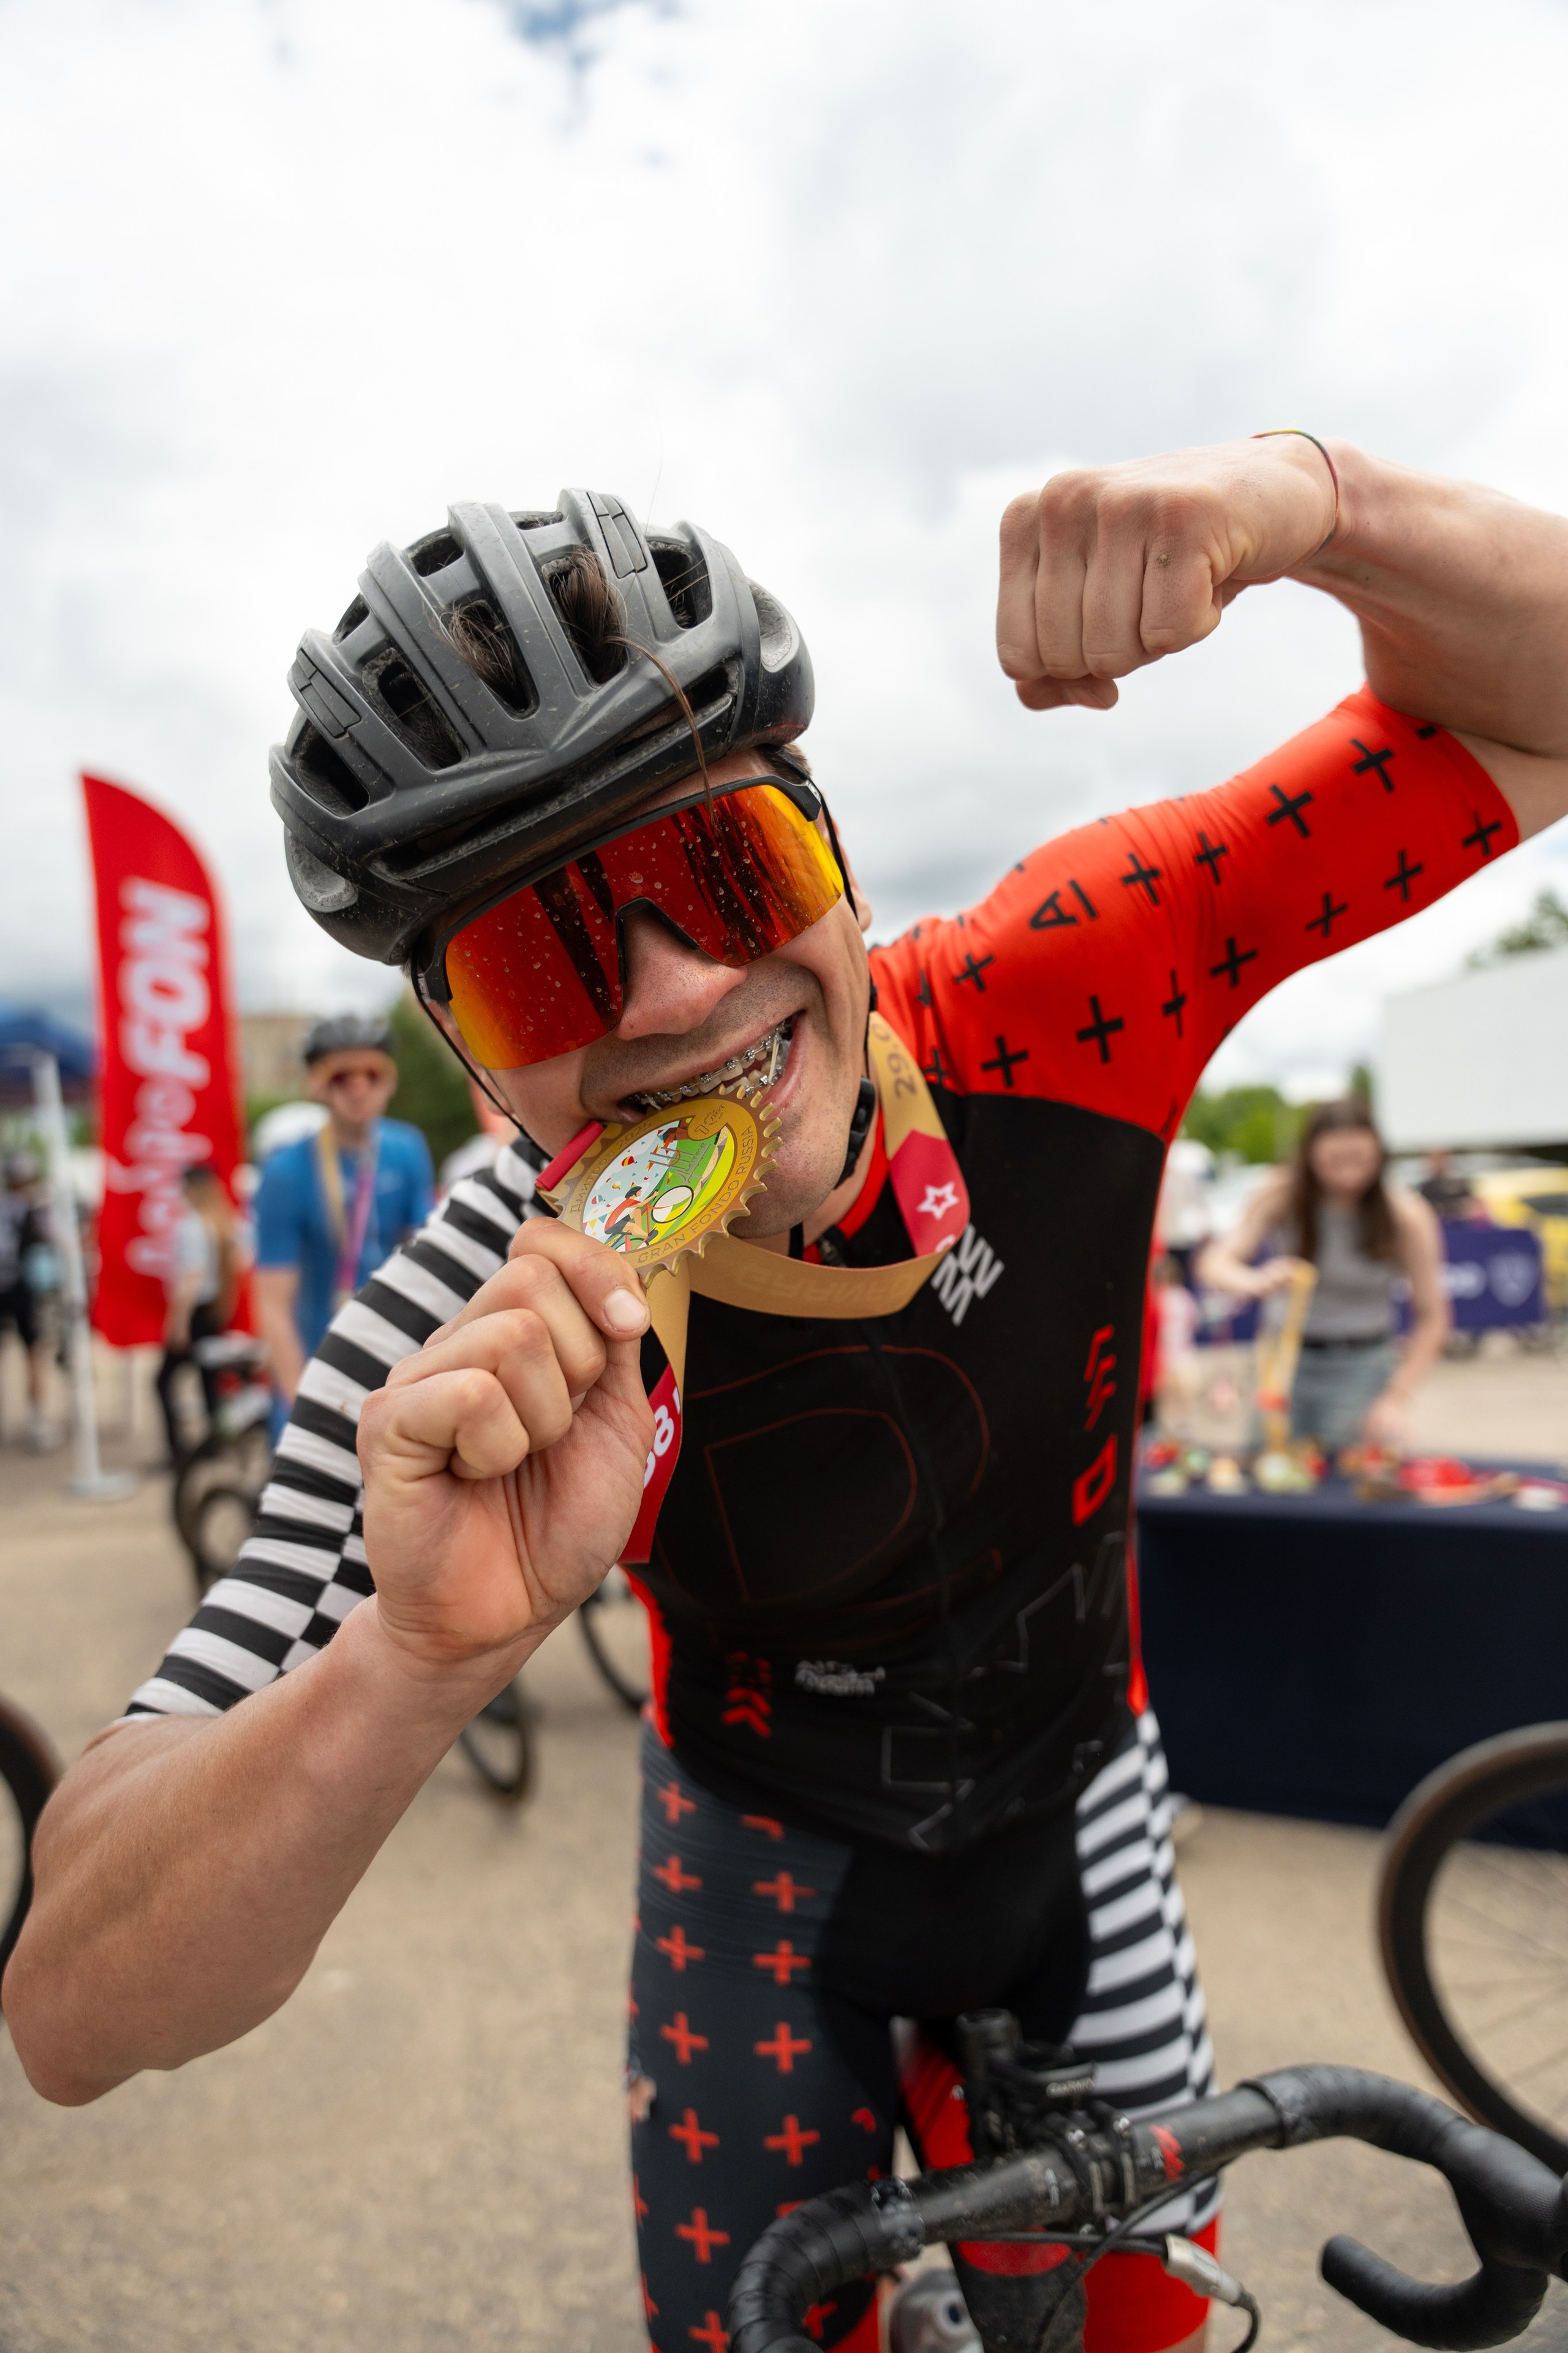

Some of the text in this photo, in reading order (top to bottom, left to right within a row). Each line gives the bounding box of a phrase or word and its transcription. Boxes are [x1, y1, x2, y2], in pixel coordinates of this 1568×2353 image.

[616, 1122, 652, 1150] 2025
[637, 1125, 755, 1264] GRAN FONDO RUSSIA
